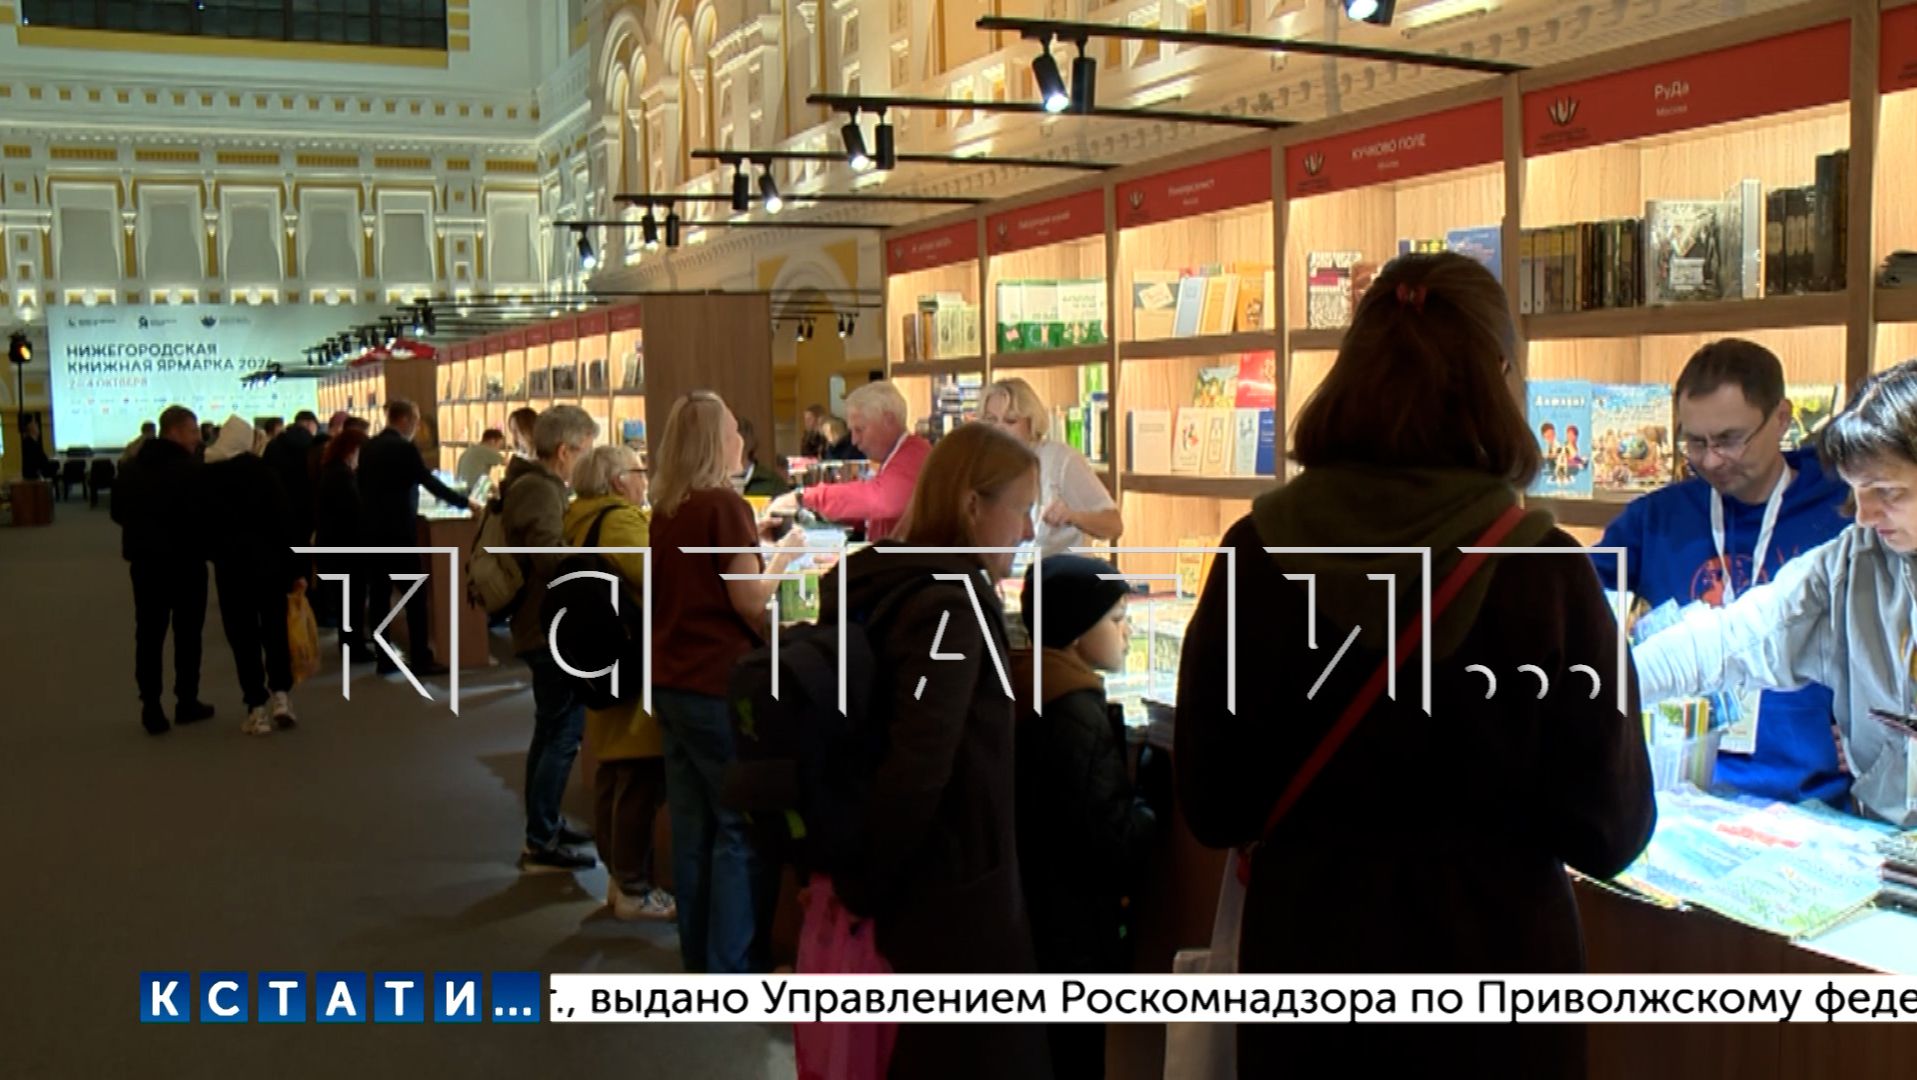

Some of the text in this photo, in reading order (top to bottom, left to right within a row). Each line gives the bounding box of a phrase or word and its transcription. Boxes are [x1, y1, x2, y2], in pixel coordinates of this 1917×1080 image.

[1654, 81, 1690, 100] РуДа
[66, 343, 218, 358] НИЖЕГОРОДСКАЯ
[67, 359, 153, 374] КНИЖНАЯ
[157, 358, 235, 372] ЯРМАРКА
